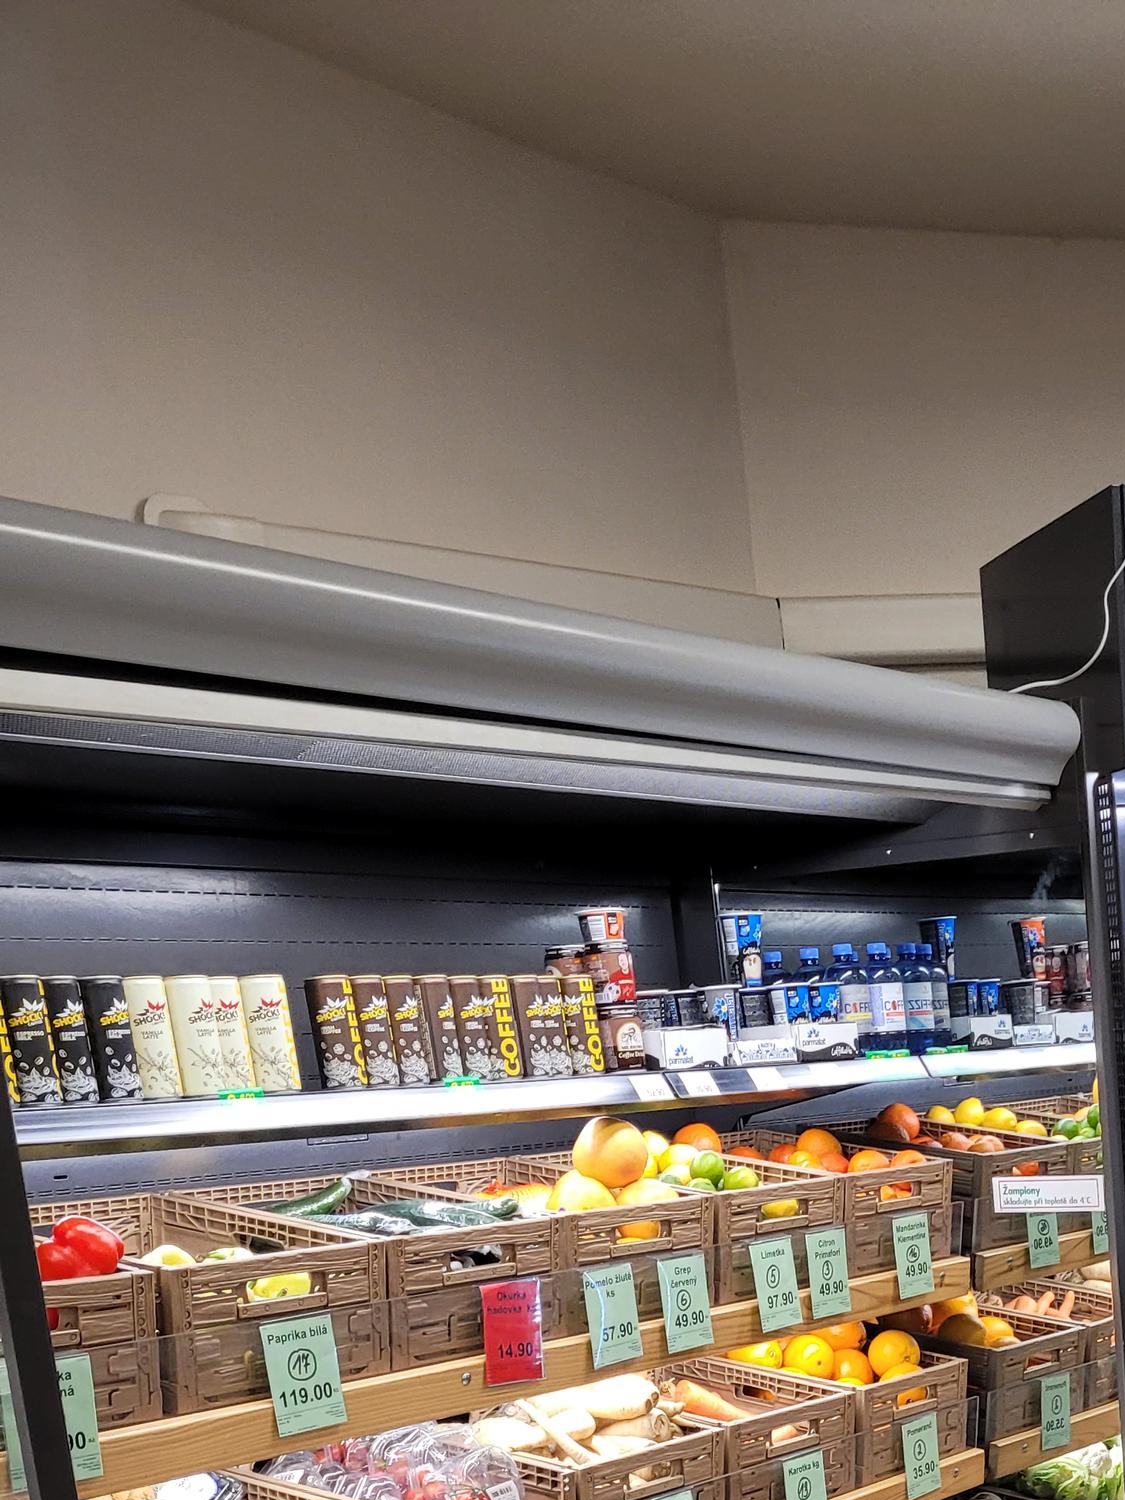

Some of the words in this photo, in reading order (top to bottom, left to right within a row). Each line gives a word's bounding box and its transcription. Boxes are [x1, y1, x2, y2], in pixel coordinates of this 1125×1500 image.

[491, 978, 521, 1076] COFFEE
[579, 977, 605, 1071] COFFEE
[1002, 1184, 1040, 1197] Žampiony
[674, 1266, 692, 1278] Grep
[770, 1269, 777, 1284] 5
[905, 1262, 928, 1278] 49.90
[819, 1280, 844, 1297] 49.90
[680, 1292, 689, 1306] 6
[767, 1291, 794, 1309] 97.90
[674, 1310, 704, 1328] 49.90
[267, 1329, 307, 1344] Paprika
[309, 1324, 328, 1338] bílá
[602, 1321, 633, 1342] 57.90
[497, 1342, 533, 1359] 14.90
[292, 1353, 310, 1375] 17
[280, 1382, 333, 1408] 119.00
[912, 1460, 935, 1480] 35.90
